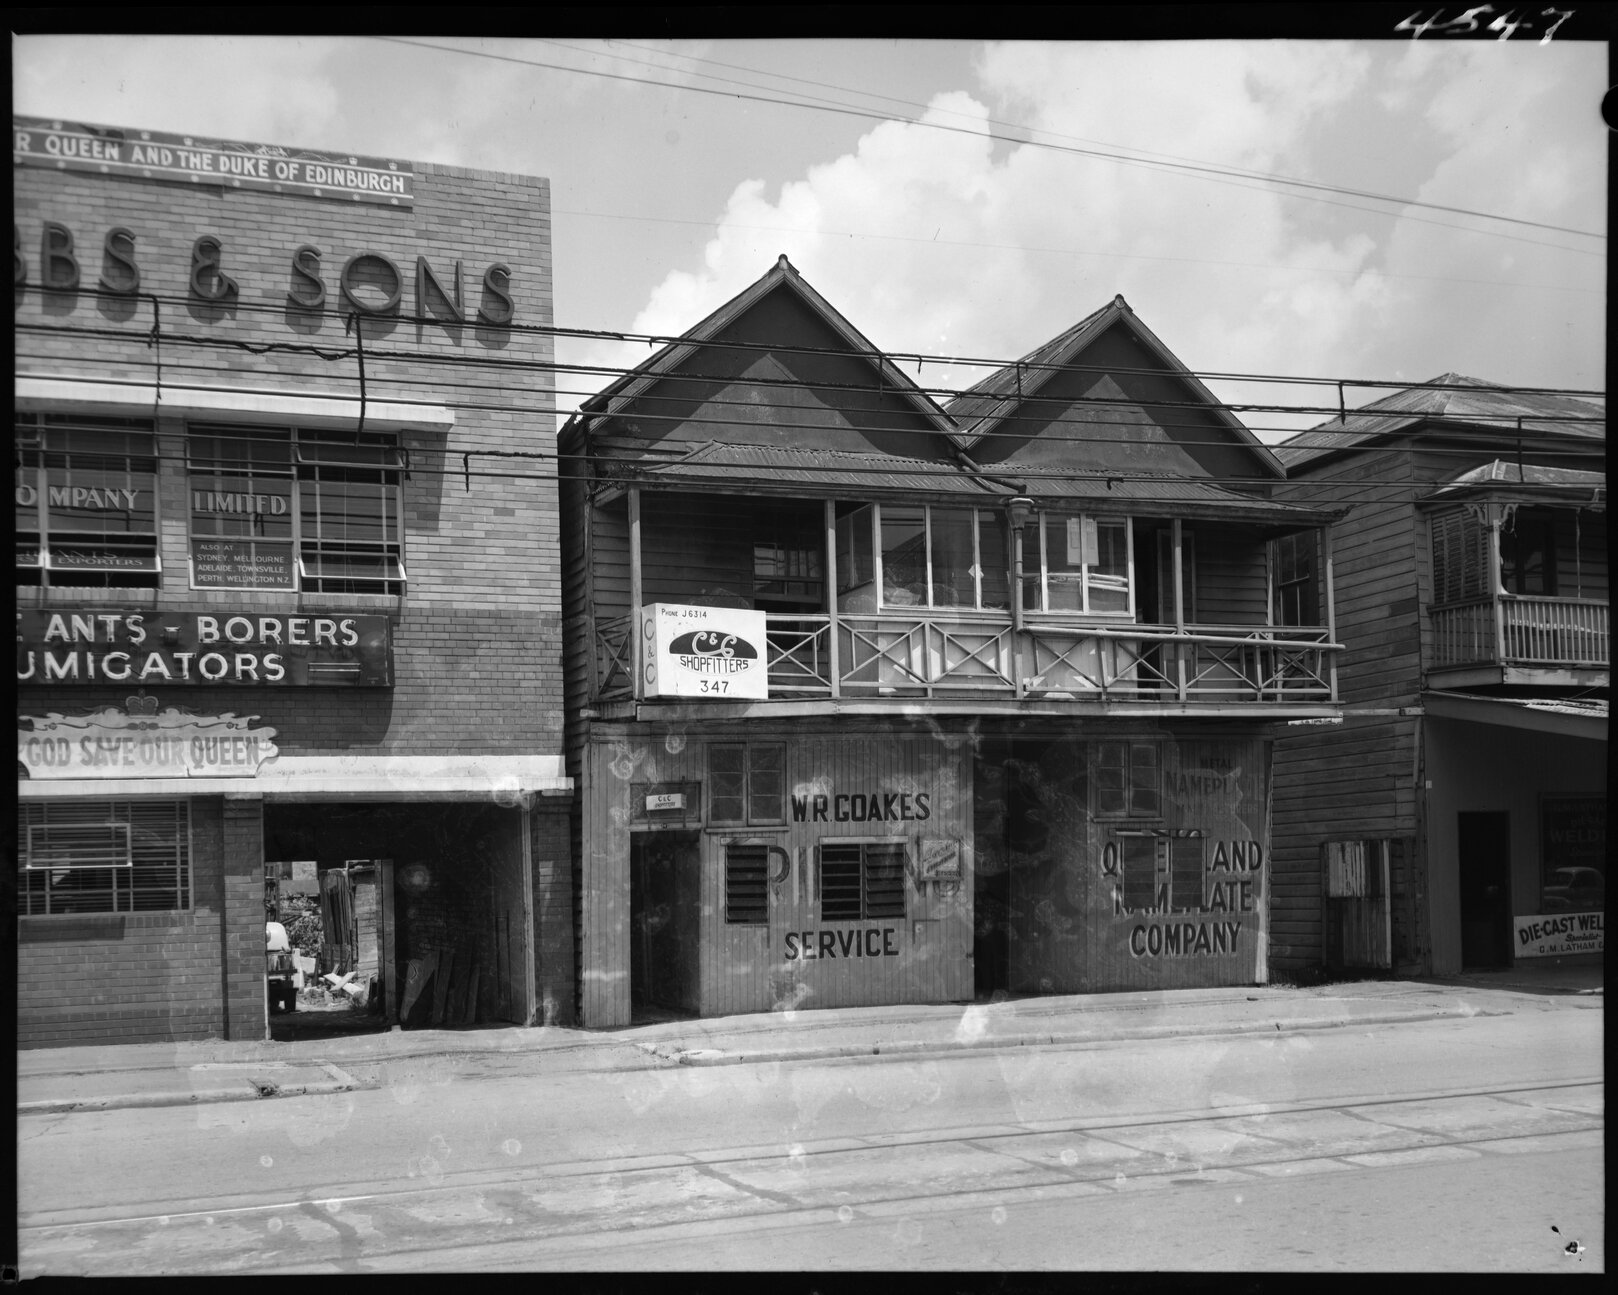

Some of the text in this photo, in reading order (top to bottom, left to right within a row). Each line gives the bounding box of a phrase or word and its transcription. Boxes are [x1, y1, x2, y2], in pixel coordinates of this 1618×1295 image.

[45, 134, 120, 160] QUEEN
[131, 144, 173, 168] AND
[177, 149, 214, 172] THE
[218, 153, 270, 179] DUKE
[275, 162, 301, 182] OF
[305, 163, 405, 193] EDINBURGH
[190, 234, 239, 301] &
[286, 243, 515, 326] SONS
[193, 491, 287, 516] LIMITED
[44, 614, 147, 644] ANTS
[197, 616, 359, 645] BORERS
[17, 650, 286, 681] UMIGATORS
[680, 656, 749, 673] SHOPFITTERS
[700, 680, 730, 694] 347
[27, 736, 260, 770] GOD SAVE OUR QUEEN
[784, 928, 900, 961] SERVICE
[1131, 922, 1242, 957] COMPANY
